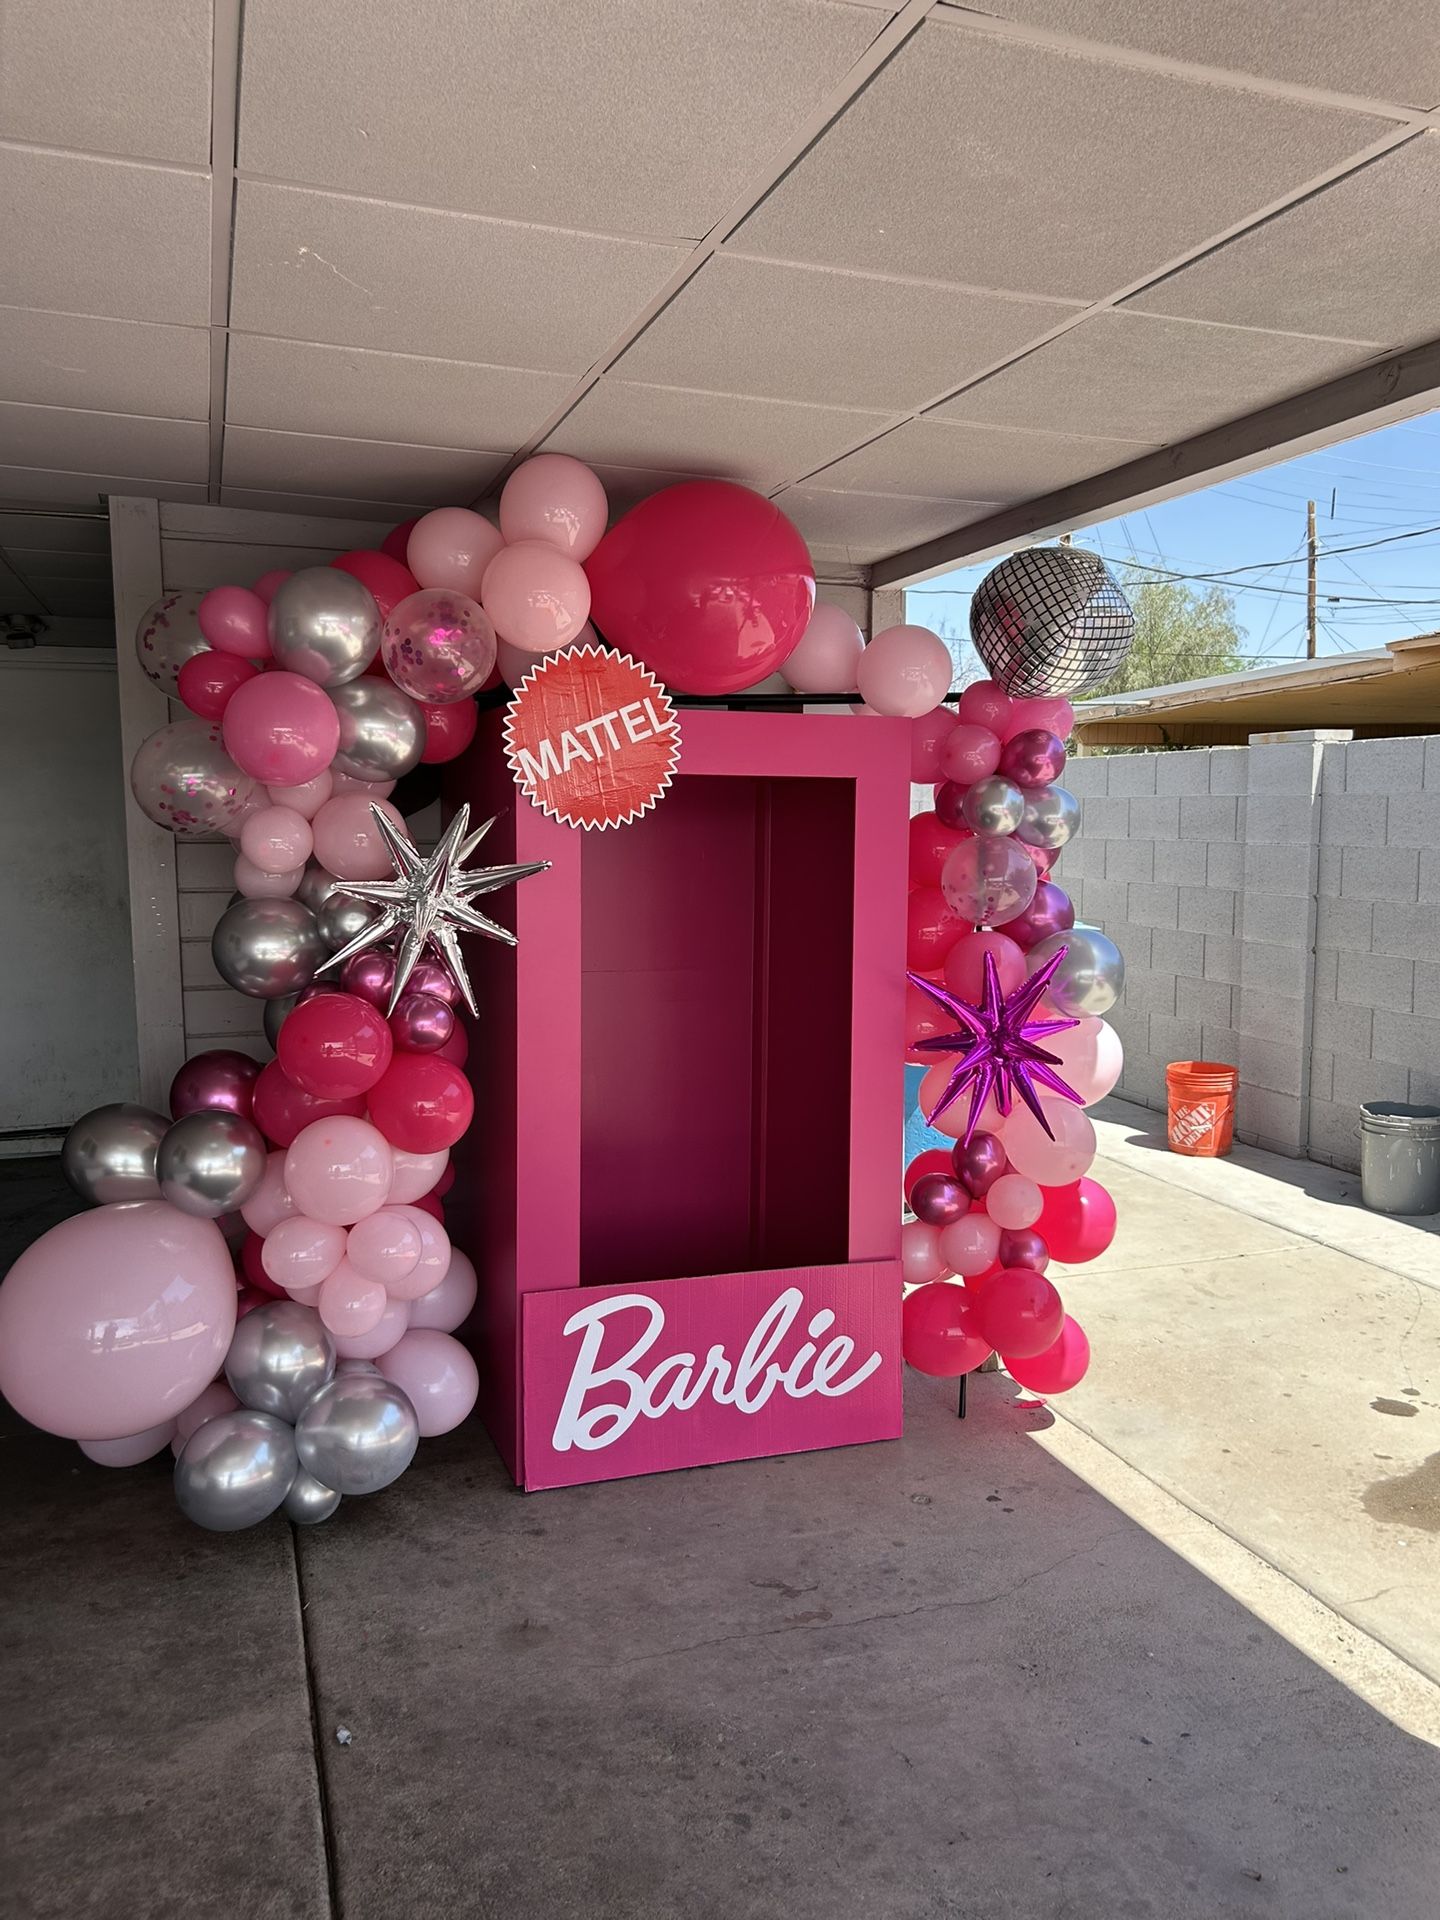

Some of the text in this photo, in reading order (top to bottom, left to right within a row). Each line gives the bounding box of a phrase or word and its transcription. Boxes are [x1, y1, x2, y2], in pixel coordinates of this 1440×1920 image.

[516, 697, 675, 786] MATTEL
[1170, 1103, 1214, 1143] HOME
[552, 1287, 882, 1451] Barbie
